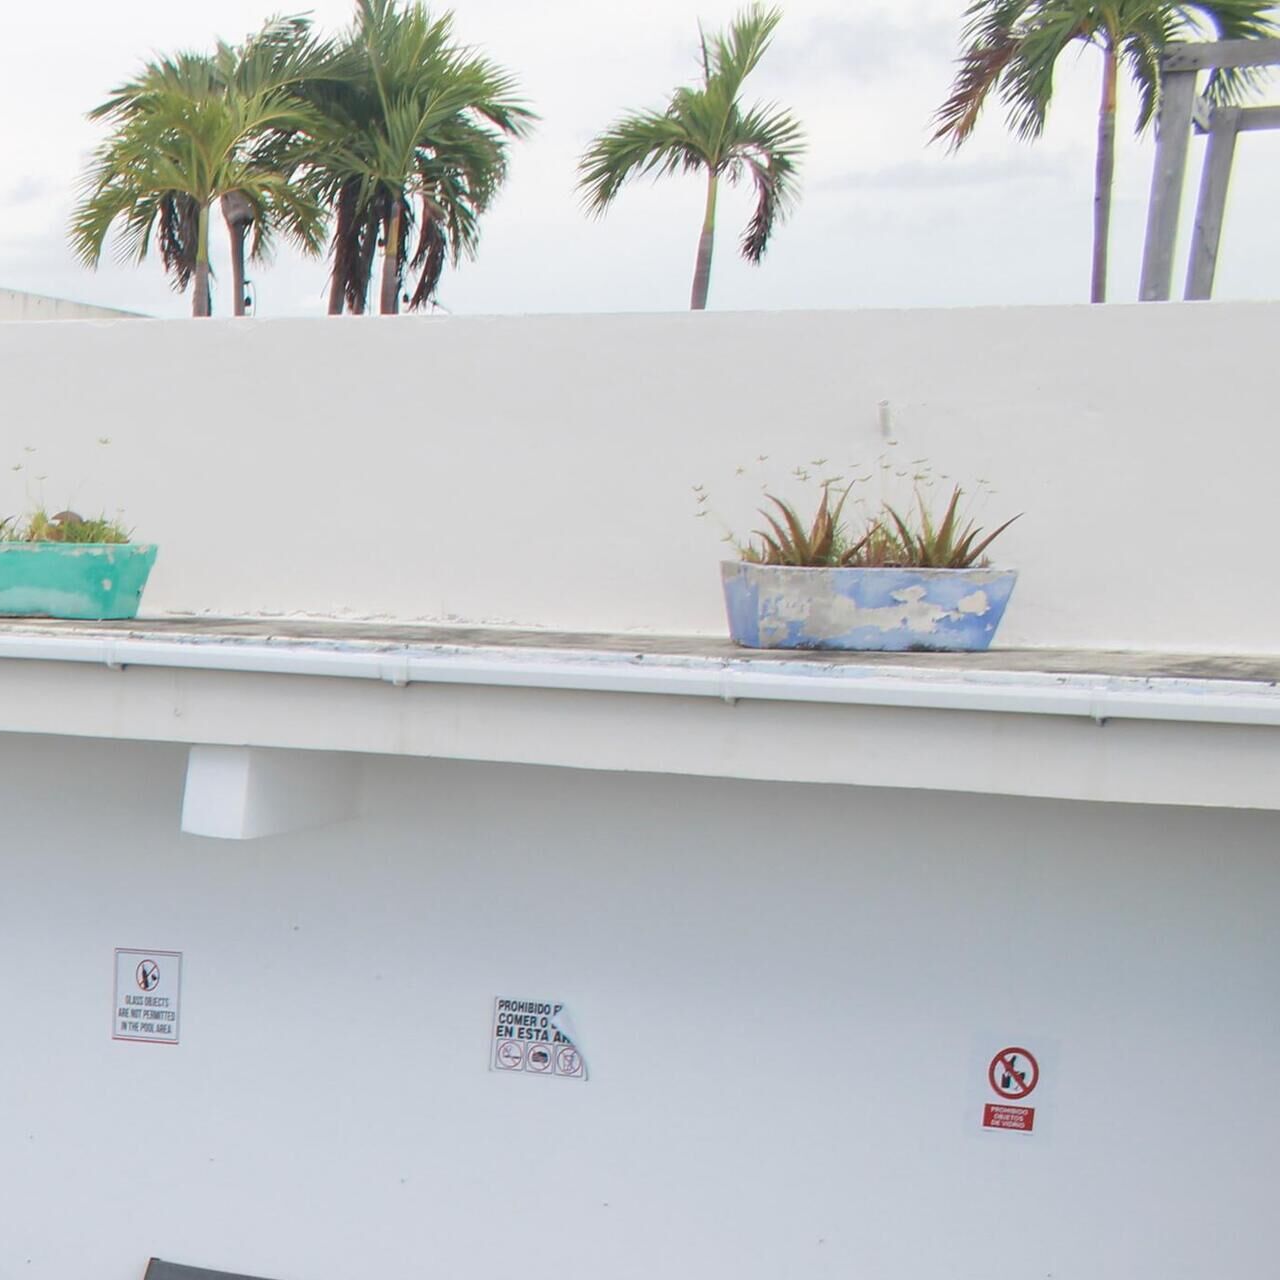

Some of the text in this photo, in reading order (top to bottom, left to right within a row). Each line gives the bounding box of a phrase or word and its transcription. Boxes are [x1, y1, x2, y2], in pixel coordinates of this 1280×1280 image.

[498, 1000, 551, 1015] PROHIBIDO
[499, 1013, 537, 1027] COMER
[540, 1017, 549, 1028] O
[496, 1026, 514, 1038] EN
[517, 1027, 549, 1041] ESTA
